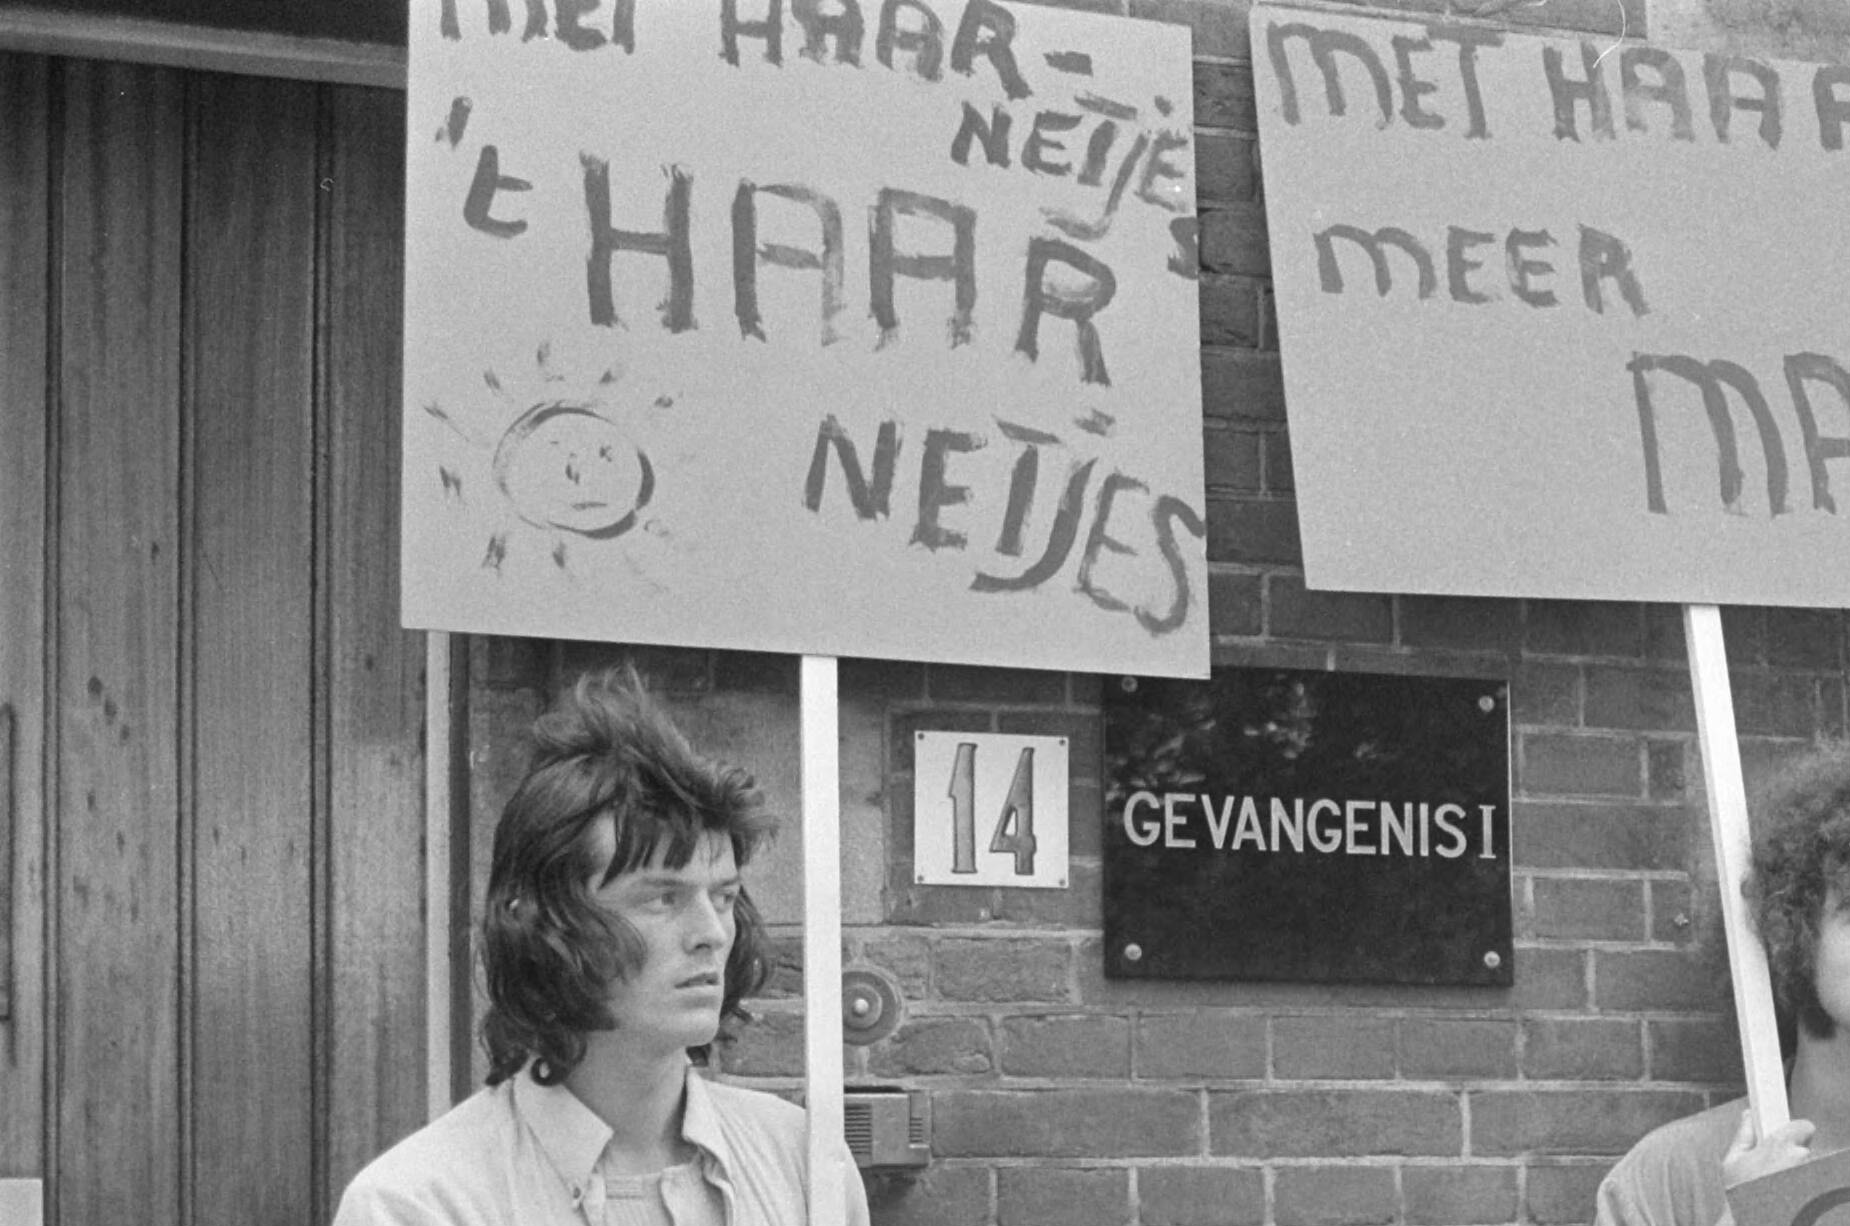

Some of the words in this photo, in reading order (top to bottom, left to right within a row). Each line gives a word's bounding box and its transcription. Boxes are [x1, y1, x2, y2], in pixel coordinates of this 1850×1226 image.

[1266, 15, 1505, 142] MET
[580, 149, 1117, 387] HAAR
[1313, 222, 1651, 315] MEER
[948, 742, 1037, 876] 14
[1123, 790, 1467, 860] GEVANGENIS
[1478, 804, 1498, 860] I
